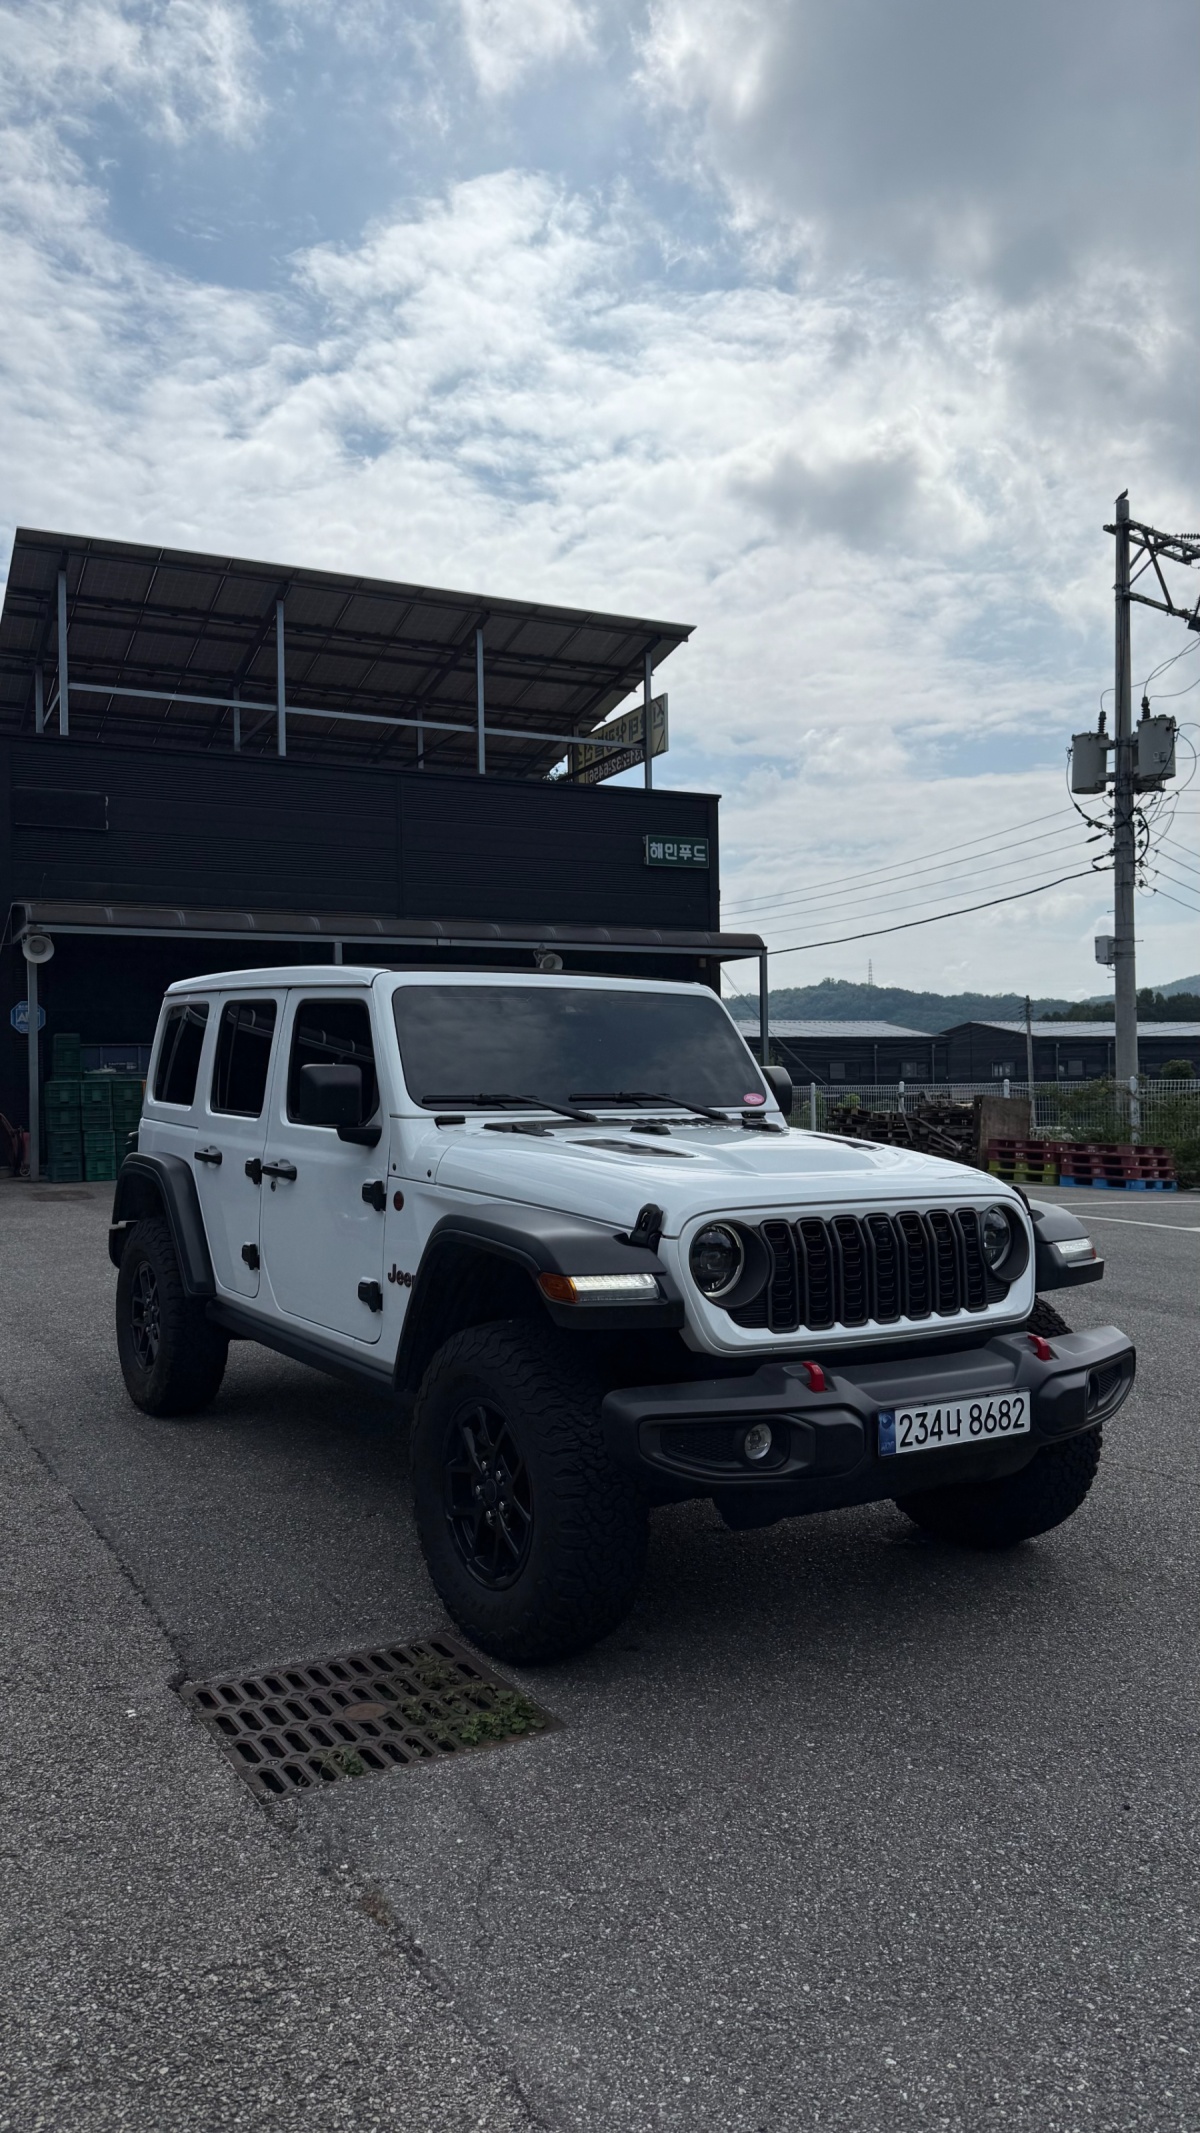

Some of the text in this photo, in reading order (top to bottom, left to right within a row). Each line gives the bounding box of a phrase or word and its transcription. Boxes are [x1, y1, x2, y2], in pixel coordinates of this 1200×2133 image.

[650, 842, 706, 862] 해민푸드
[899, 1397, 1025, 1447] 234나 8682
